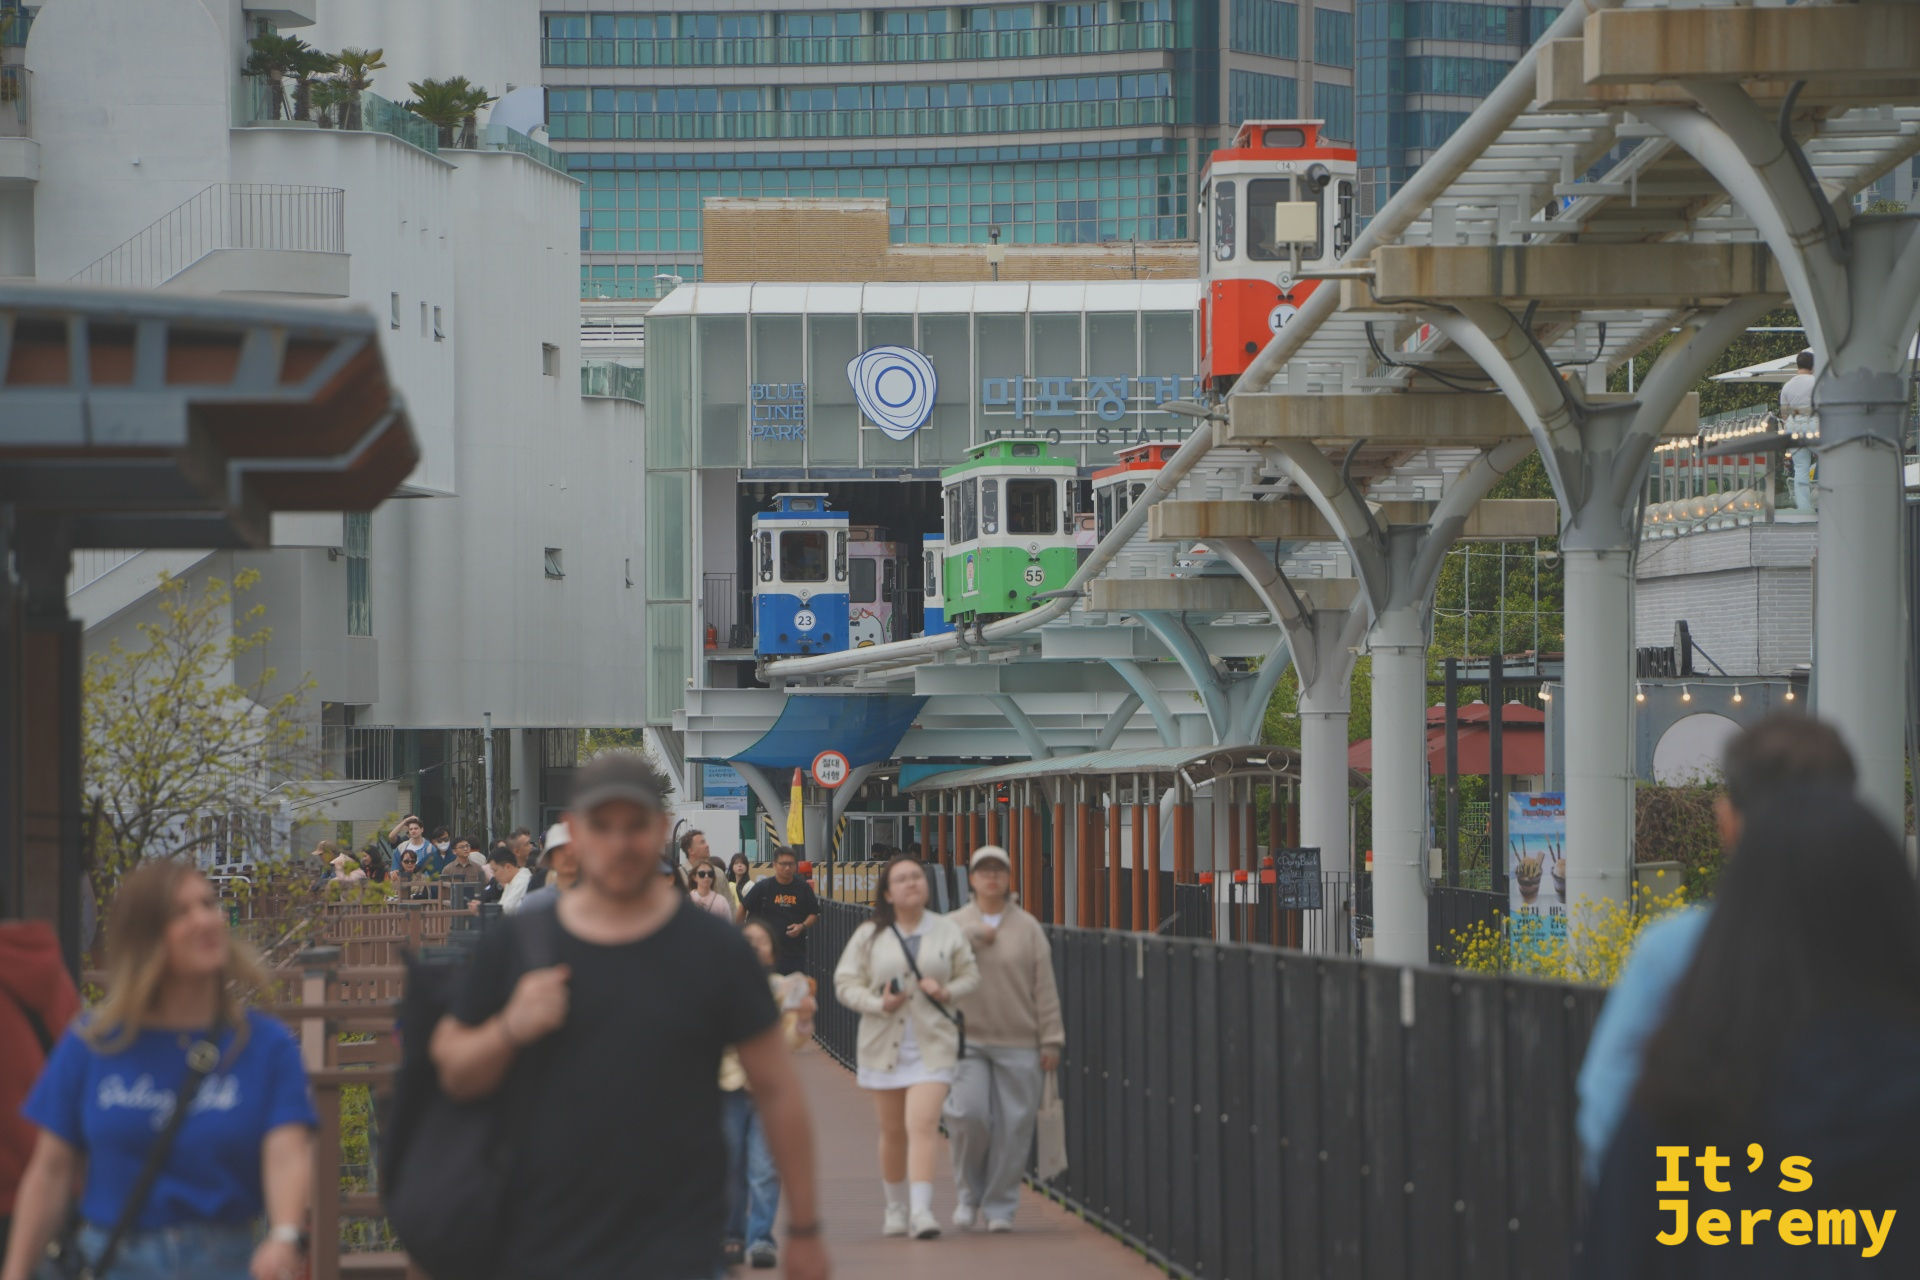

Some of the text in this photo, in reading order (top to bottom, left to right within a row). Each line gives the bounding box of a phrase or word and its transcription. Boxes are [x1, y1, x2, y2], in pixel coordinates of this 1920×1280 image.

[1282, 162, 1290, 170] 14
[751, 383, 805, 400] BLUE
[751, 404, 805, 421] LINE
[751, 424, 805, 441] PARK
[1096, 427, 1199, 446] STATI
[1025, 569, 1043, 582] 55
[797, 615, 812, 626] 23
[821, 758, 840, 768] 절대
[821, 770, 840, 781] 서행
[833, 873, 880, 891] FIRS
